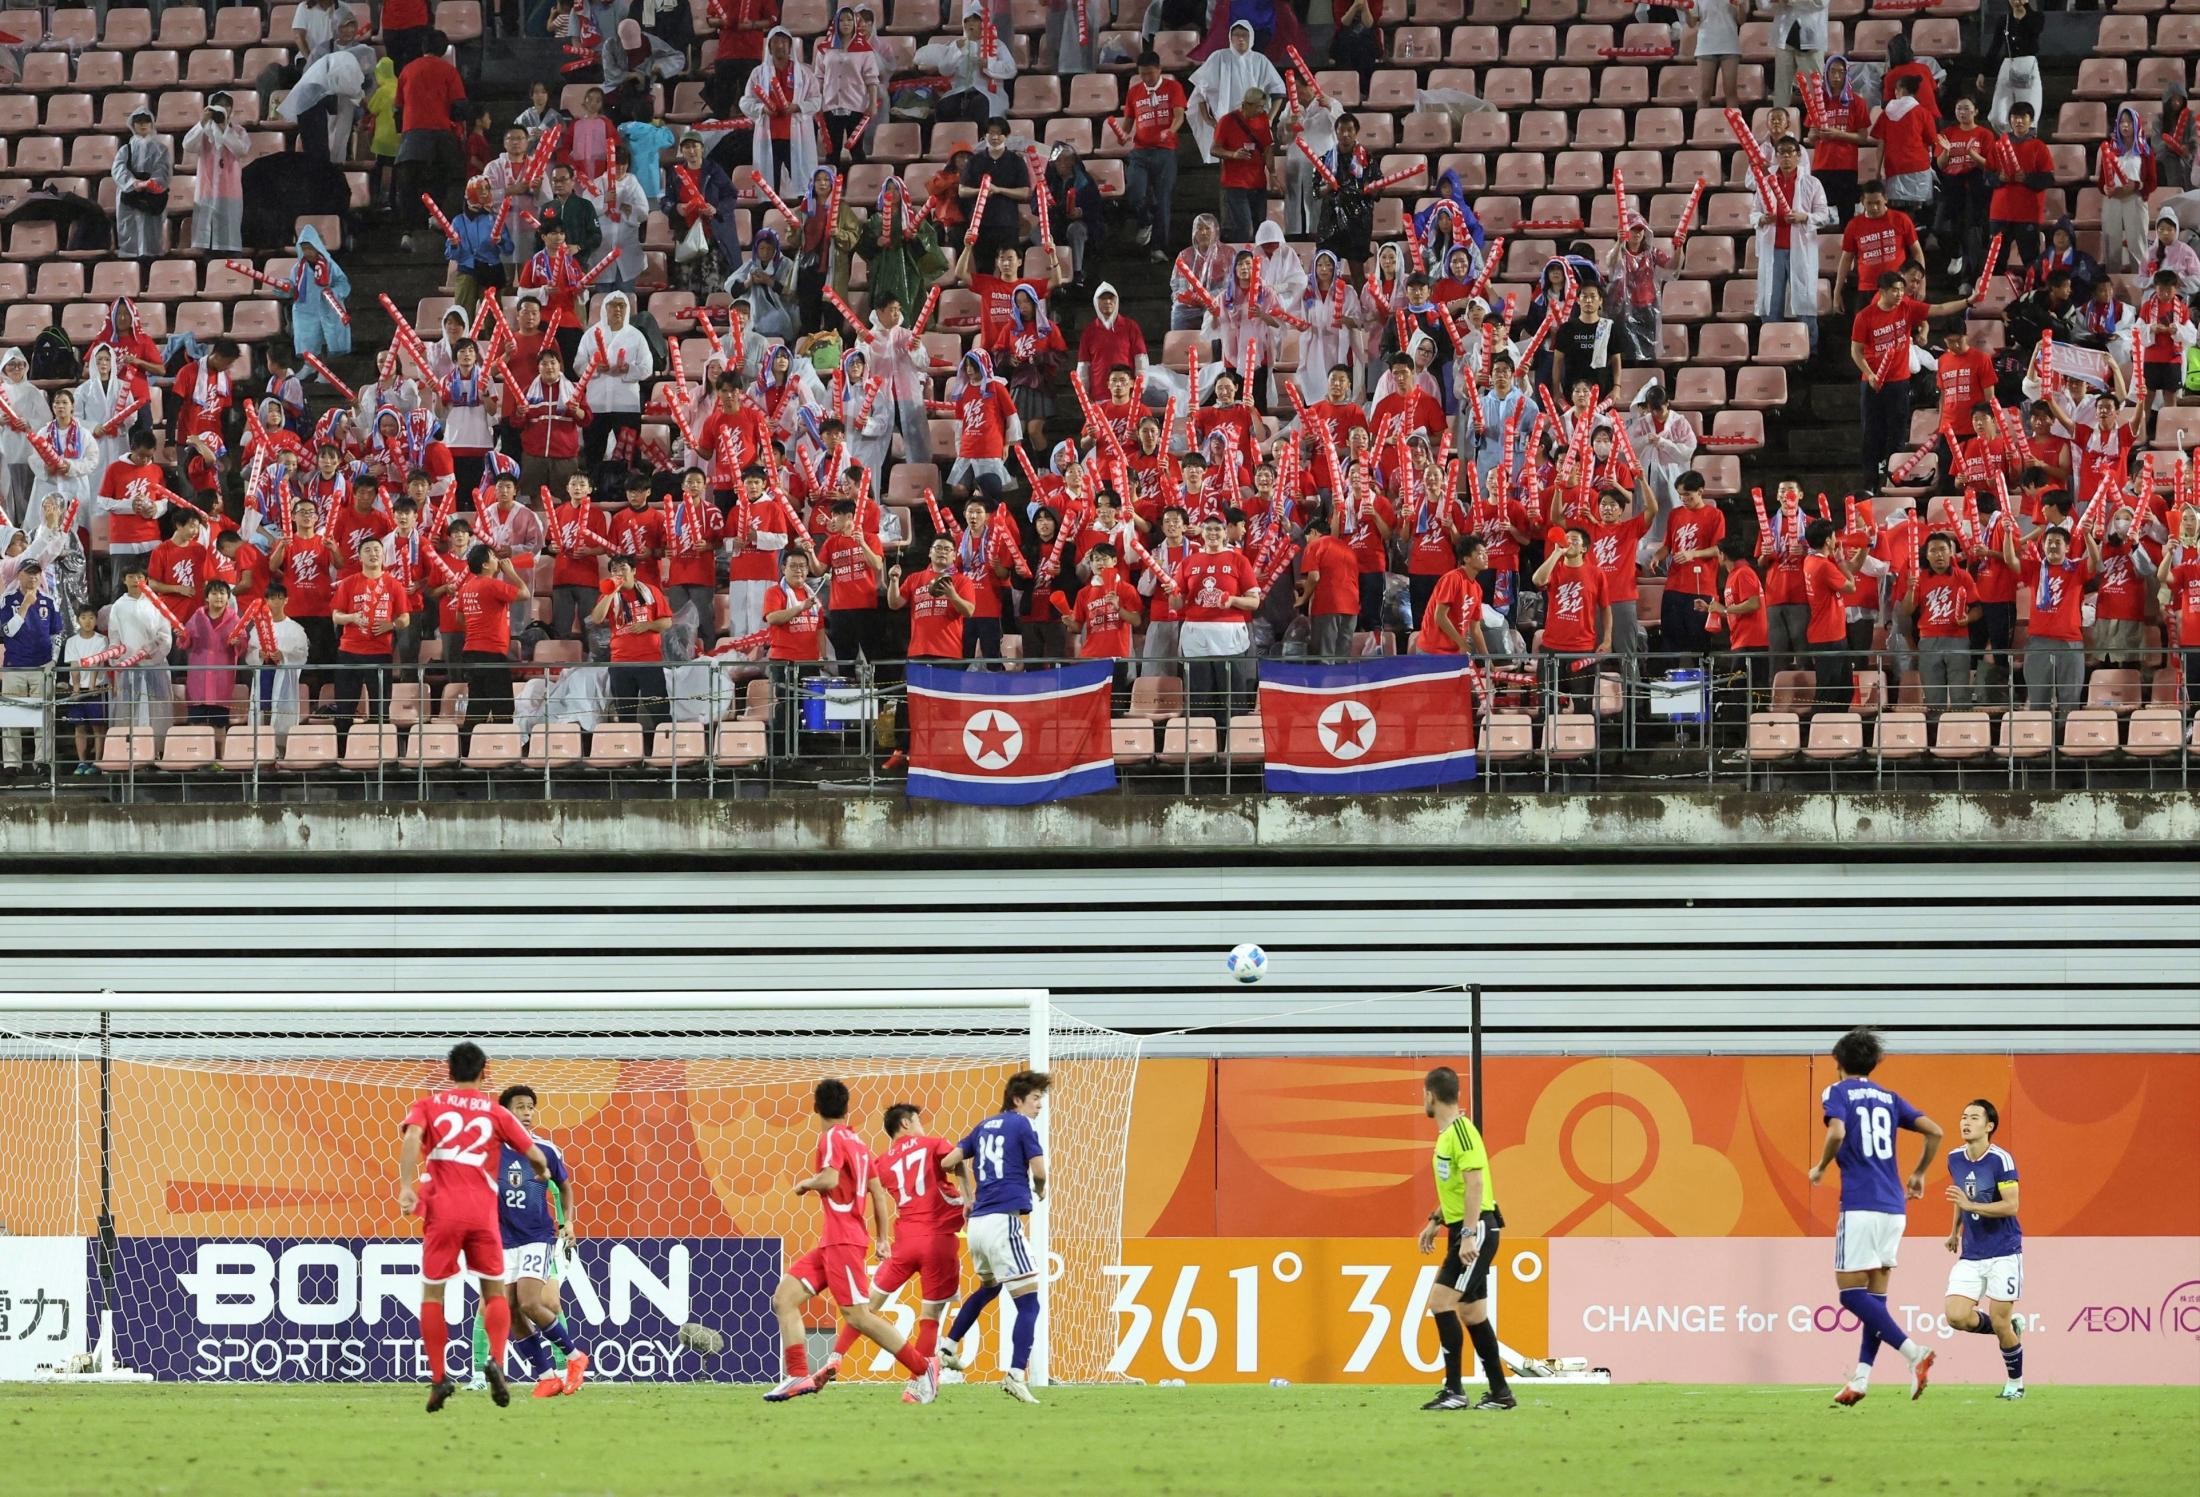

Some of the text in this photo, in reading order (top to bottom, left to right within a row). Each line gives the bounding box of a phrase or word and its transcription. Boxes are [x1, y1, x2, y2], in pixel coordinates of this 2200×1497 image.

[1860, 229, 1896, 244] 이겨라! 조선
[1883, 246, 1897, 255] 조선
[1873, 324, 1894, 338] 이겨라!
[1959, 368, 1971, 377] 조선
[1958, 385, 1970, 394] 조선
[1674, 523, 1700, 544] 필승
[1592, 535, 1618, 559] 필승
[1595, 549, 1621, 565] 조선
[292, 549, 319, 573] 필승
[293, 565, 320, 584] 조선
[1556, 580, 1584, 605] 필승
[1925, 586, 1950, 608] 필승
[935, 599, 948, 608] 조선
[1555, 596, 1584, 615] 조선
[1930, 601, 1956, 620] 조선
[427, 1111, 494, 1167] 22
[1856, 1106, 1893, 1160] 18
[978, 1134, 1005, 1182] 14
[890, 1147, 928, 1207] 17
[505, 1189, 527, 1210] 22
[521, 1253, 543, 1274] 22
[177, 1243, 690, 1326] BORN
[2006, 1276, 2016, 1297] 5
[0, 1288, 70, 1341] 力
[1102, 1251, 1303, 1373] 361°
[1582, 1305, 2046, 1340] CHANGE for GOO Toger.
[195, 1338, 685, 1378] SPORTS TECNOGY
